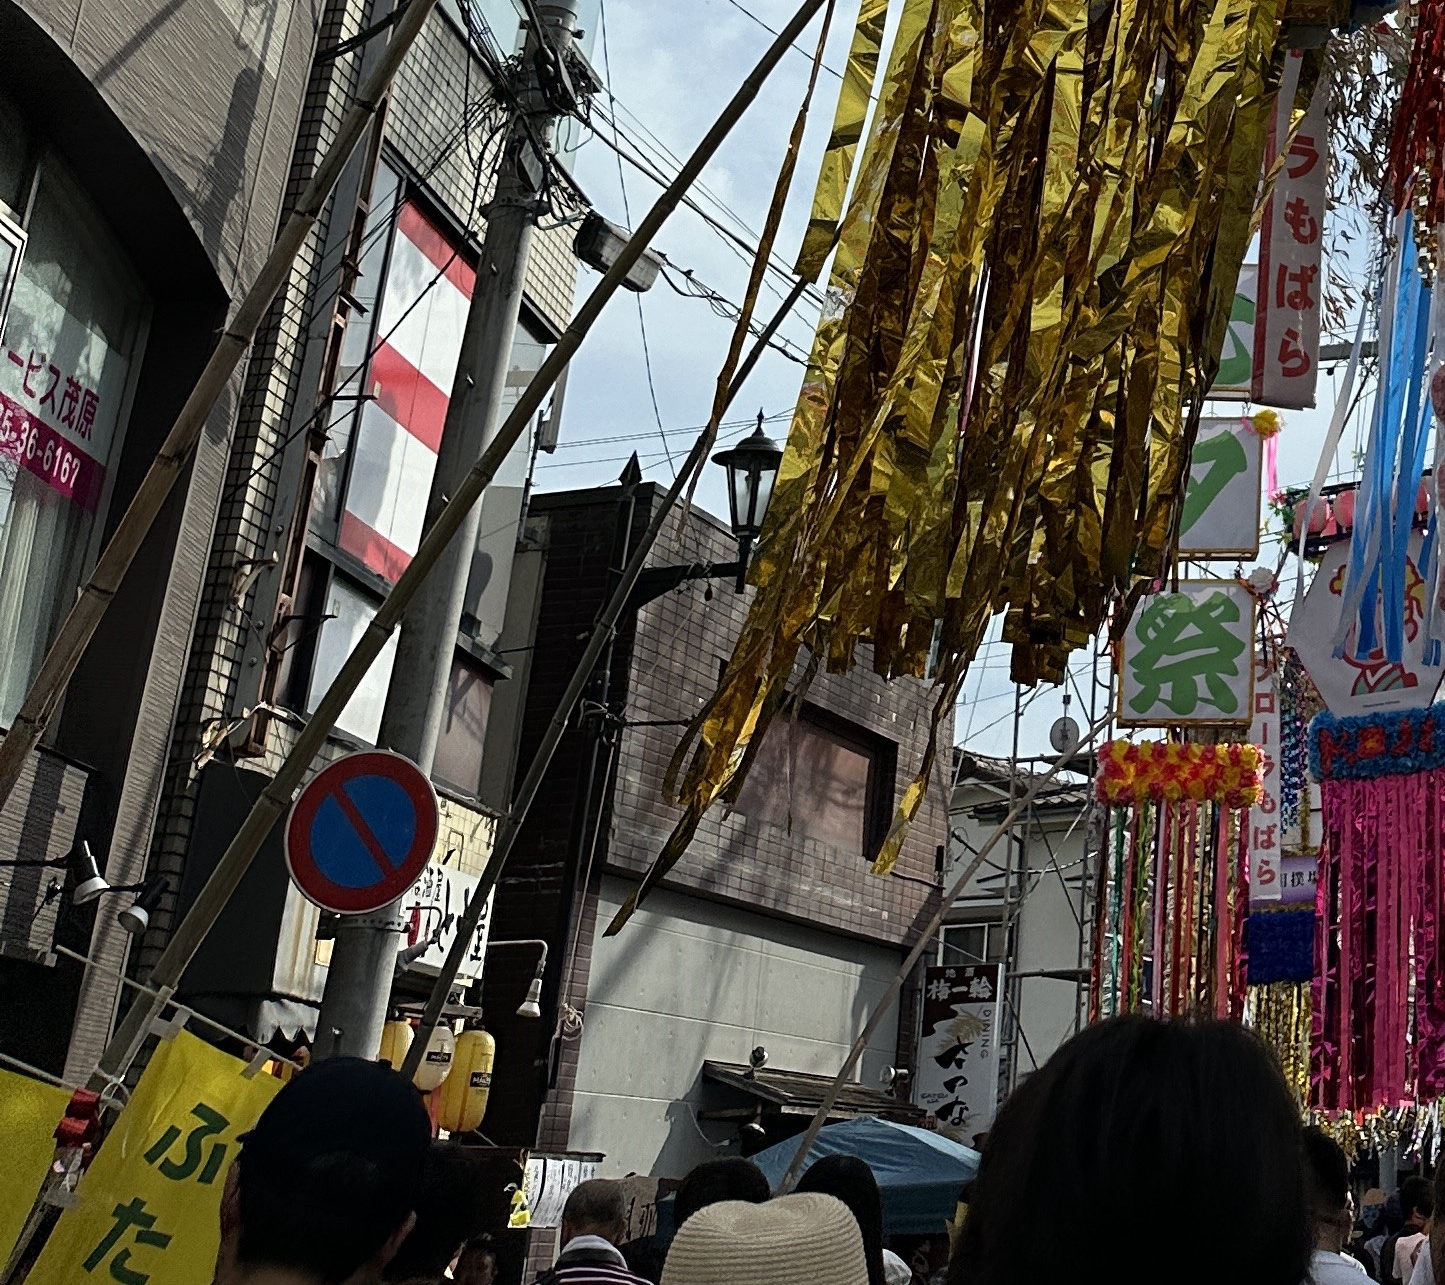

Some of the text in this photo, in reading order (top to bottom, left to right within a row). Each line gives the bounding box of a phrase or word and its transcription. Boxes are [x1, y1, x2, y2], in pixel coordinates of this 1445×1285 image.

[0, 403, 81, 489] 5-36-6167
[926, 976, 994, 1002] 梅一輪
[979, 1008, 991, 1060] DINING
